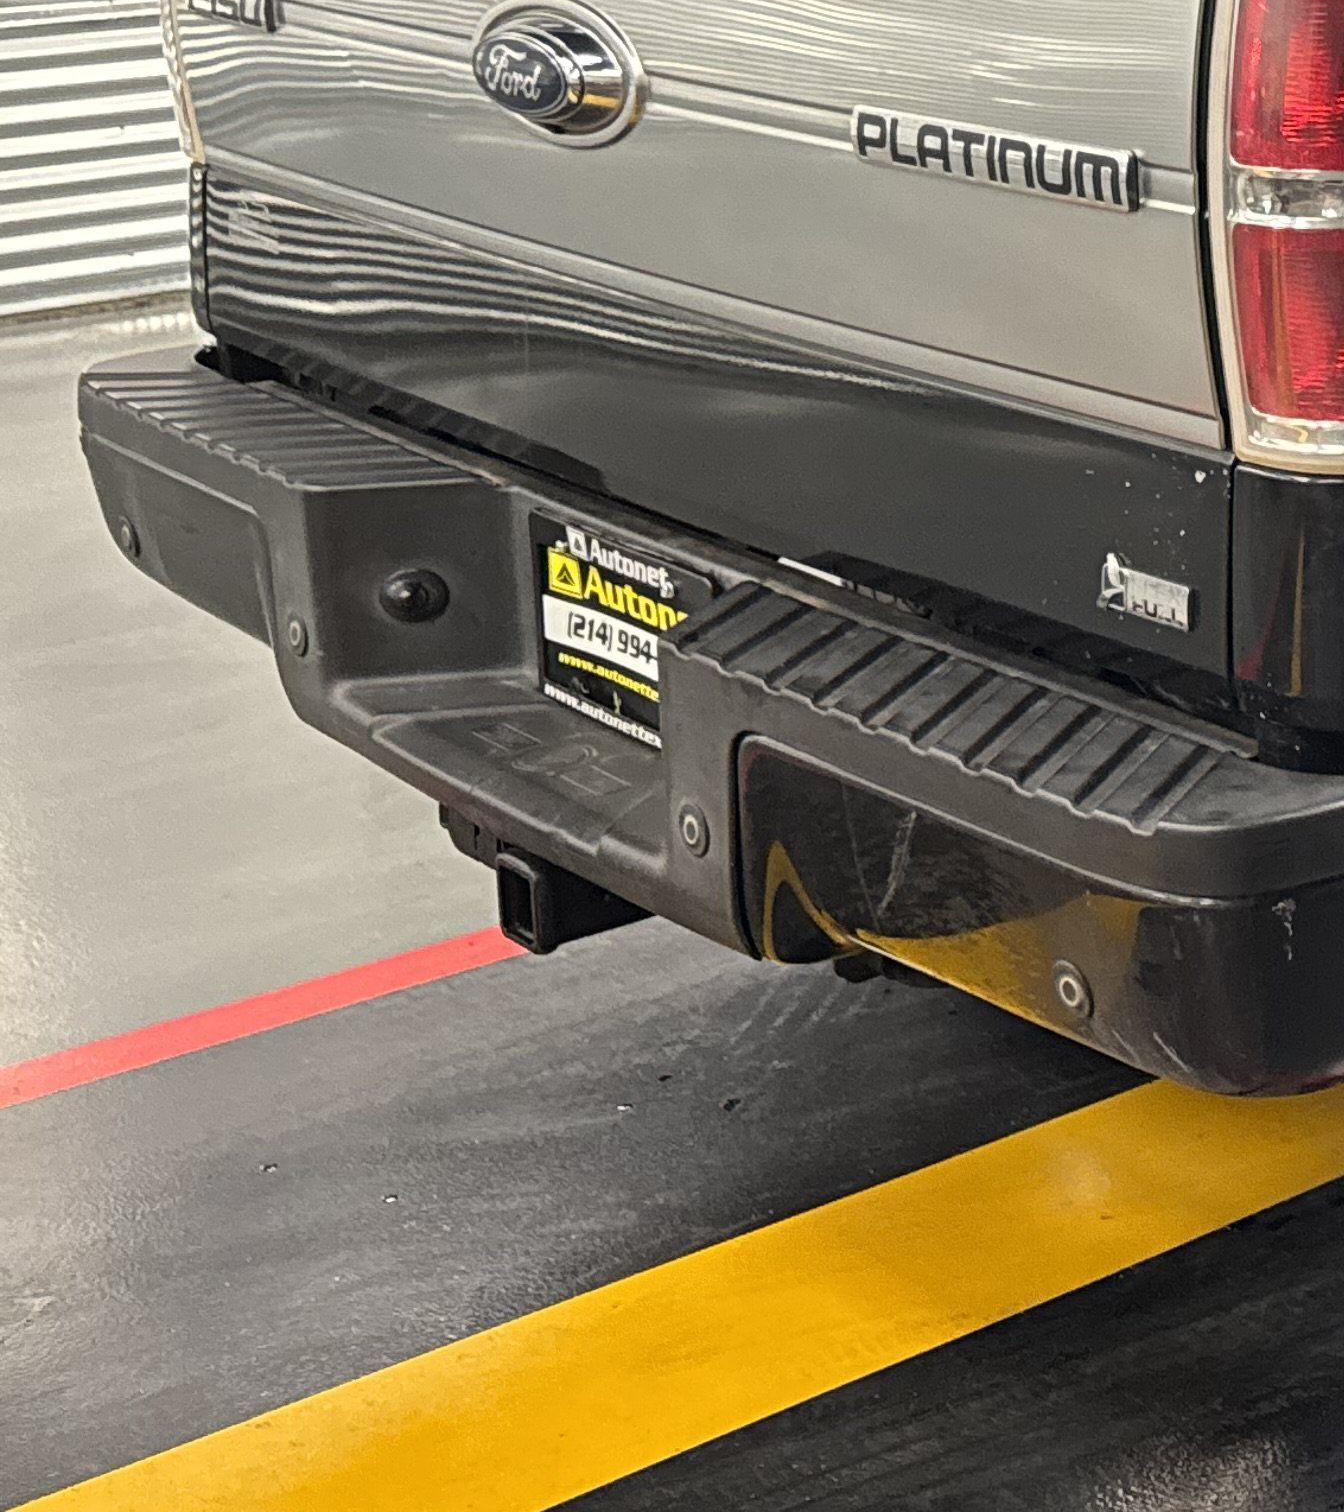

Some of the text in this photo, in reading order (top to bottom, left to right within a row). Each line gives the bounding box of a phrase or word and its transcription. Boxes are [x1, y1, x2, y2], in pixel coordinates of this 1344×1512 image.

[484, 43, 543, 103] Ford
[856, 109, 1127, 208] PLATINUM
[567, 611, 613, 652] (214)
